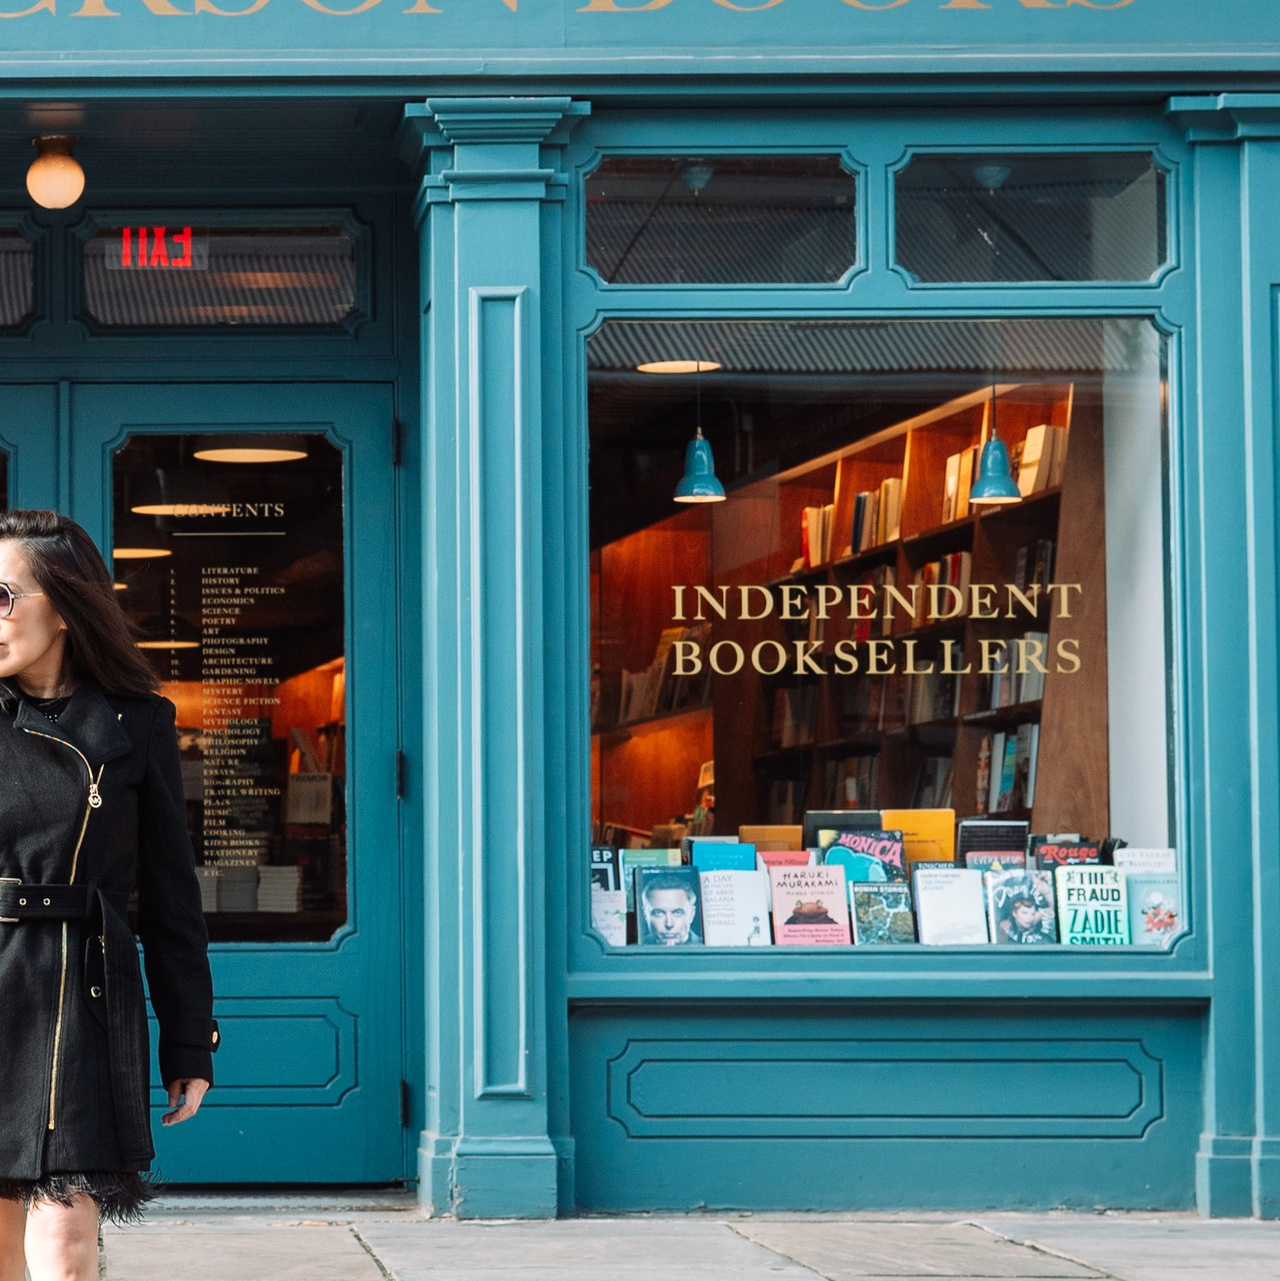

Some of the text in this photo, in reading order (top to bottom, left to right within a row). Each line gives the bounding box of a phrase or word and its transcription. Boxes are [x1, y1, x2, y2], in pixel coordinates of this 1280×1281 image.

[174, 503, 285, 517] CONTENTS
[671, 583, 1082, 620] INDEPENDENT
[672, 638, 1082, 676] BOOKSELLERS
[203, 758, 239, 766] NATURE
[203, 778, 255, 786] BIOGRAPHY
[837, 833, 903, 869] MONICA
[1040, 845, 1098, 865] Rouge
[783, 871, 829, 880] HARUKI
[777, 880, 838, 888] MURAKAMI
[1067, 888, 1121, 901] FRAUD
[1067, 909, 1123, 934] ZADIE
